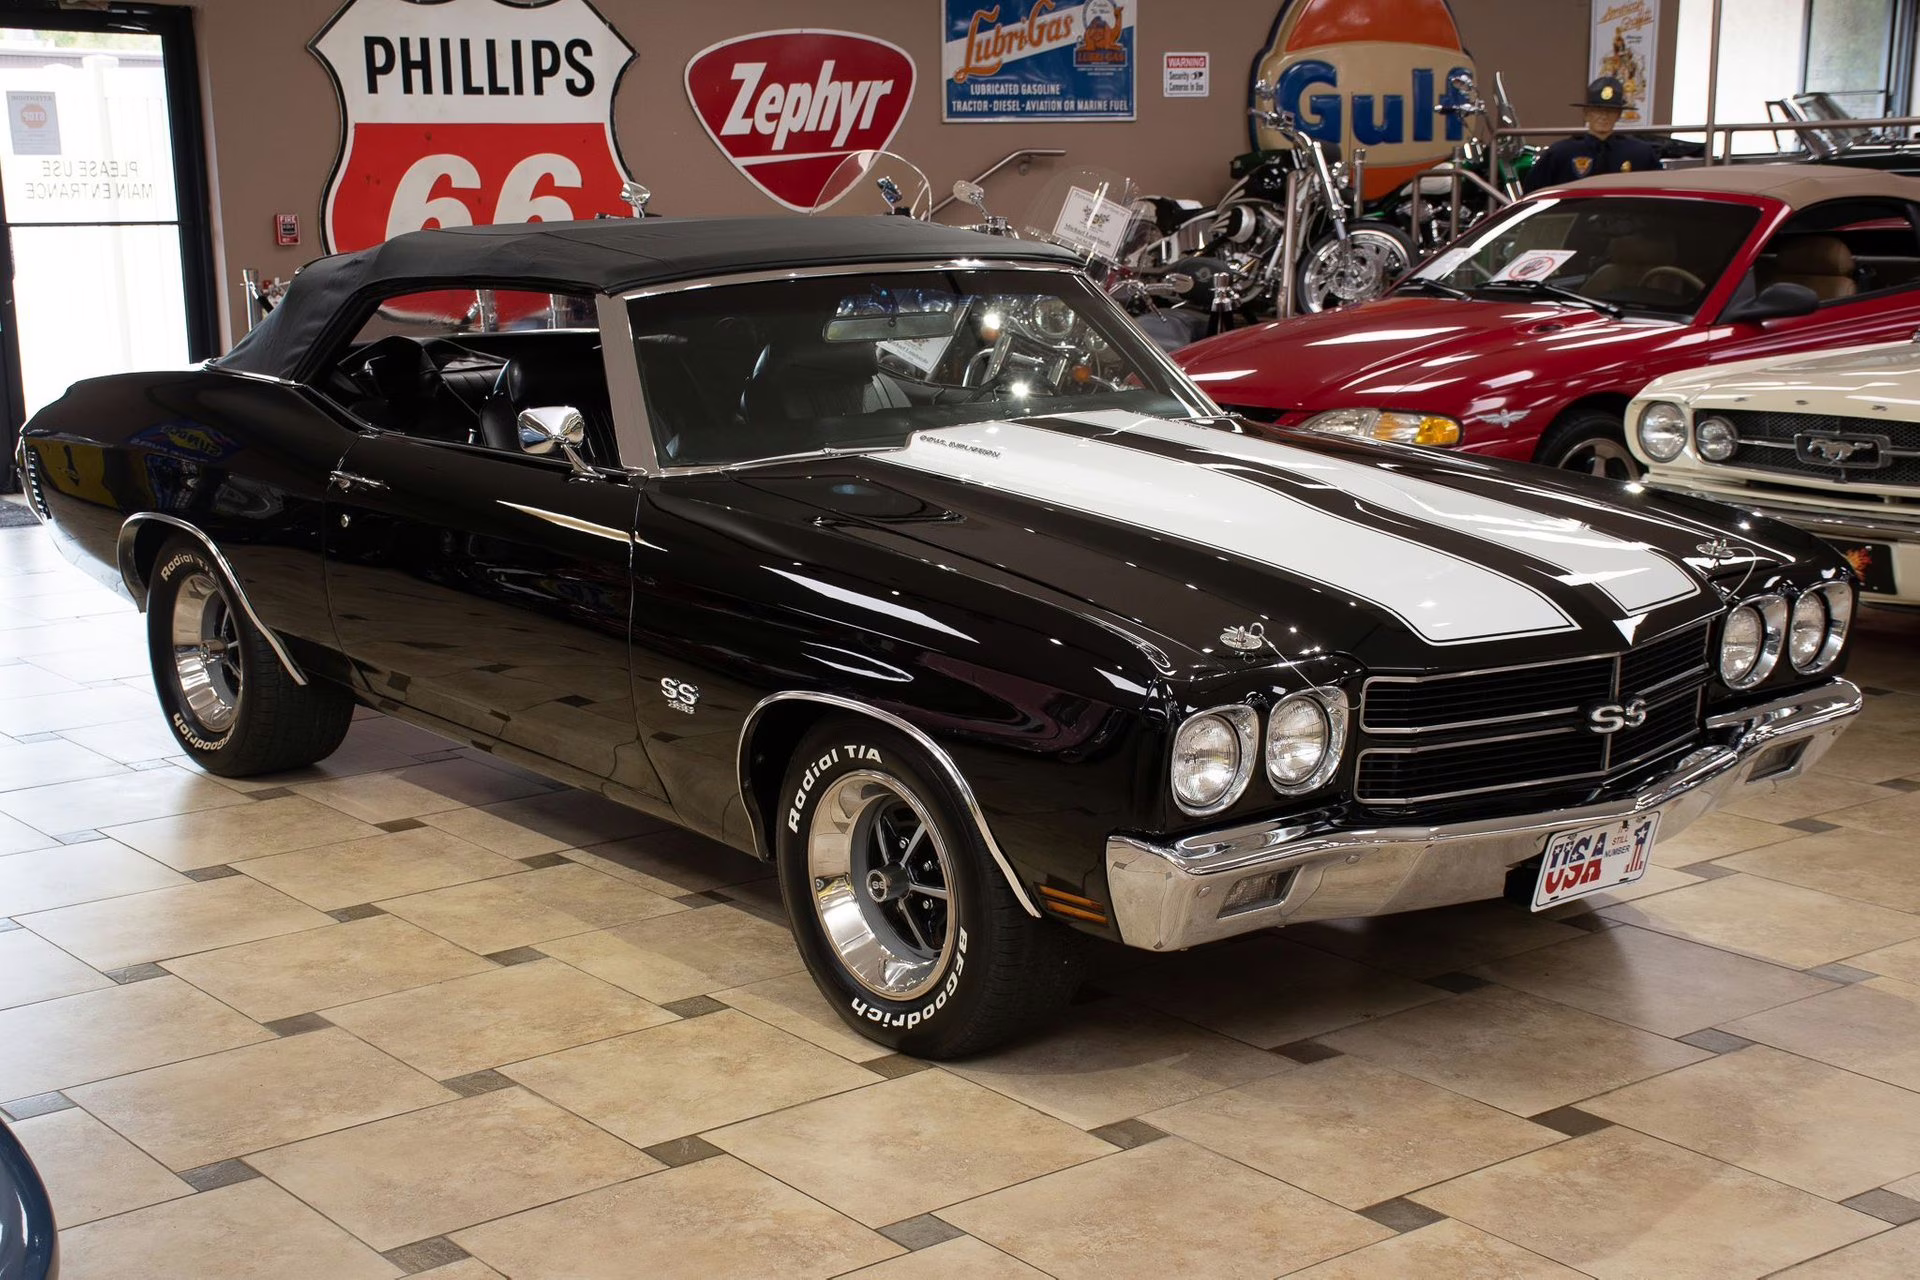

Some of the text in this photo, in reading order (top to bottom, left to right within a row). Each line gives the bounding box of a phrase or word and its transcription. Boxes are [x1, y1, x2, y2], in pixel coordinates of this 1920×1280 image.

[363, 36, 595, 97] PHILLIPS
[1167, 57, 1206, 68] WARNING
[1169, 71, 1189, 82] Security
[720, 59, 895, 150] Zephyr
[970, 84, 1061, 96] LUBRICATED GASOLINE
[1064, 100, 1075, 112] OR
[1077, 100, 1107, 112] MARINE
[1109, 100, 1128, 112] FUEL
[1275, 59, 1474, 146] Gulf
[385, 153, 583, 240] 66
[160, 553, 194, 582] Radial
[661, 677, 699, 705] SS
[1590, 699, 1647, 734] SS
[788, 745, 883, 834] Radial T/A
[1604, 845, 1630, 857] NUMBER
[1612, 834, 1629, 846] STILL
[1545, 831, 1608, 895] USA
[851, 926, 968, 1029] BFGoodrich
